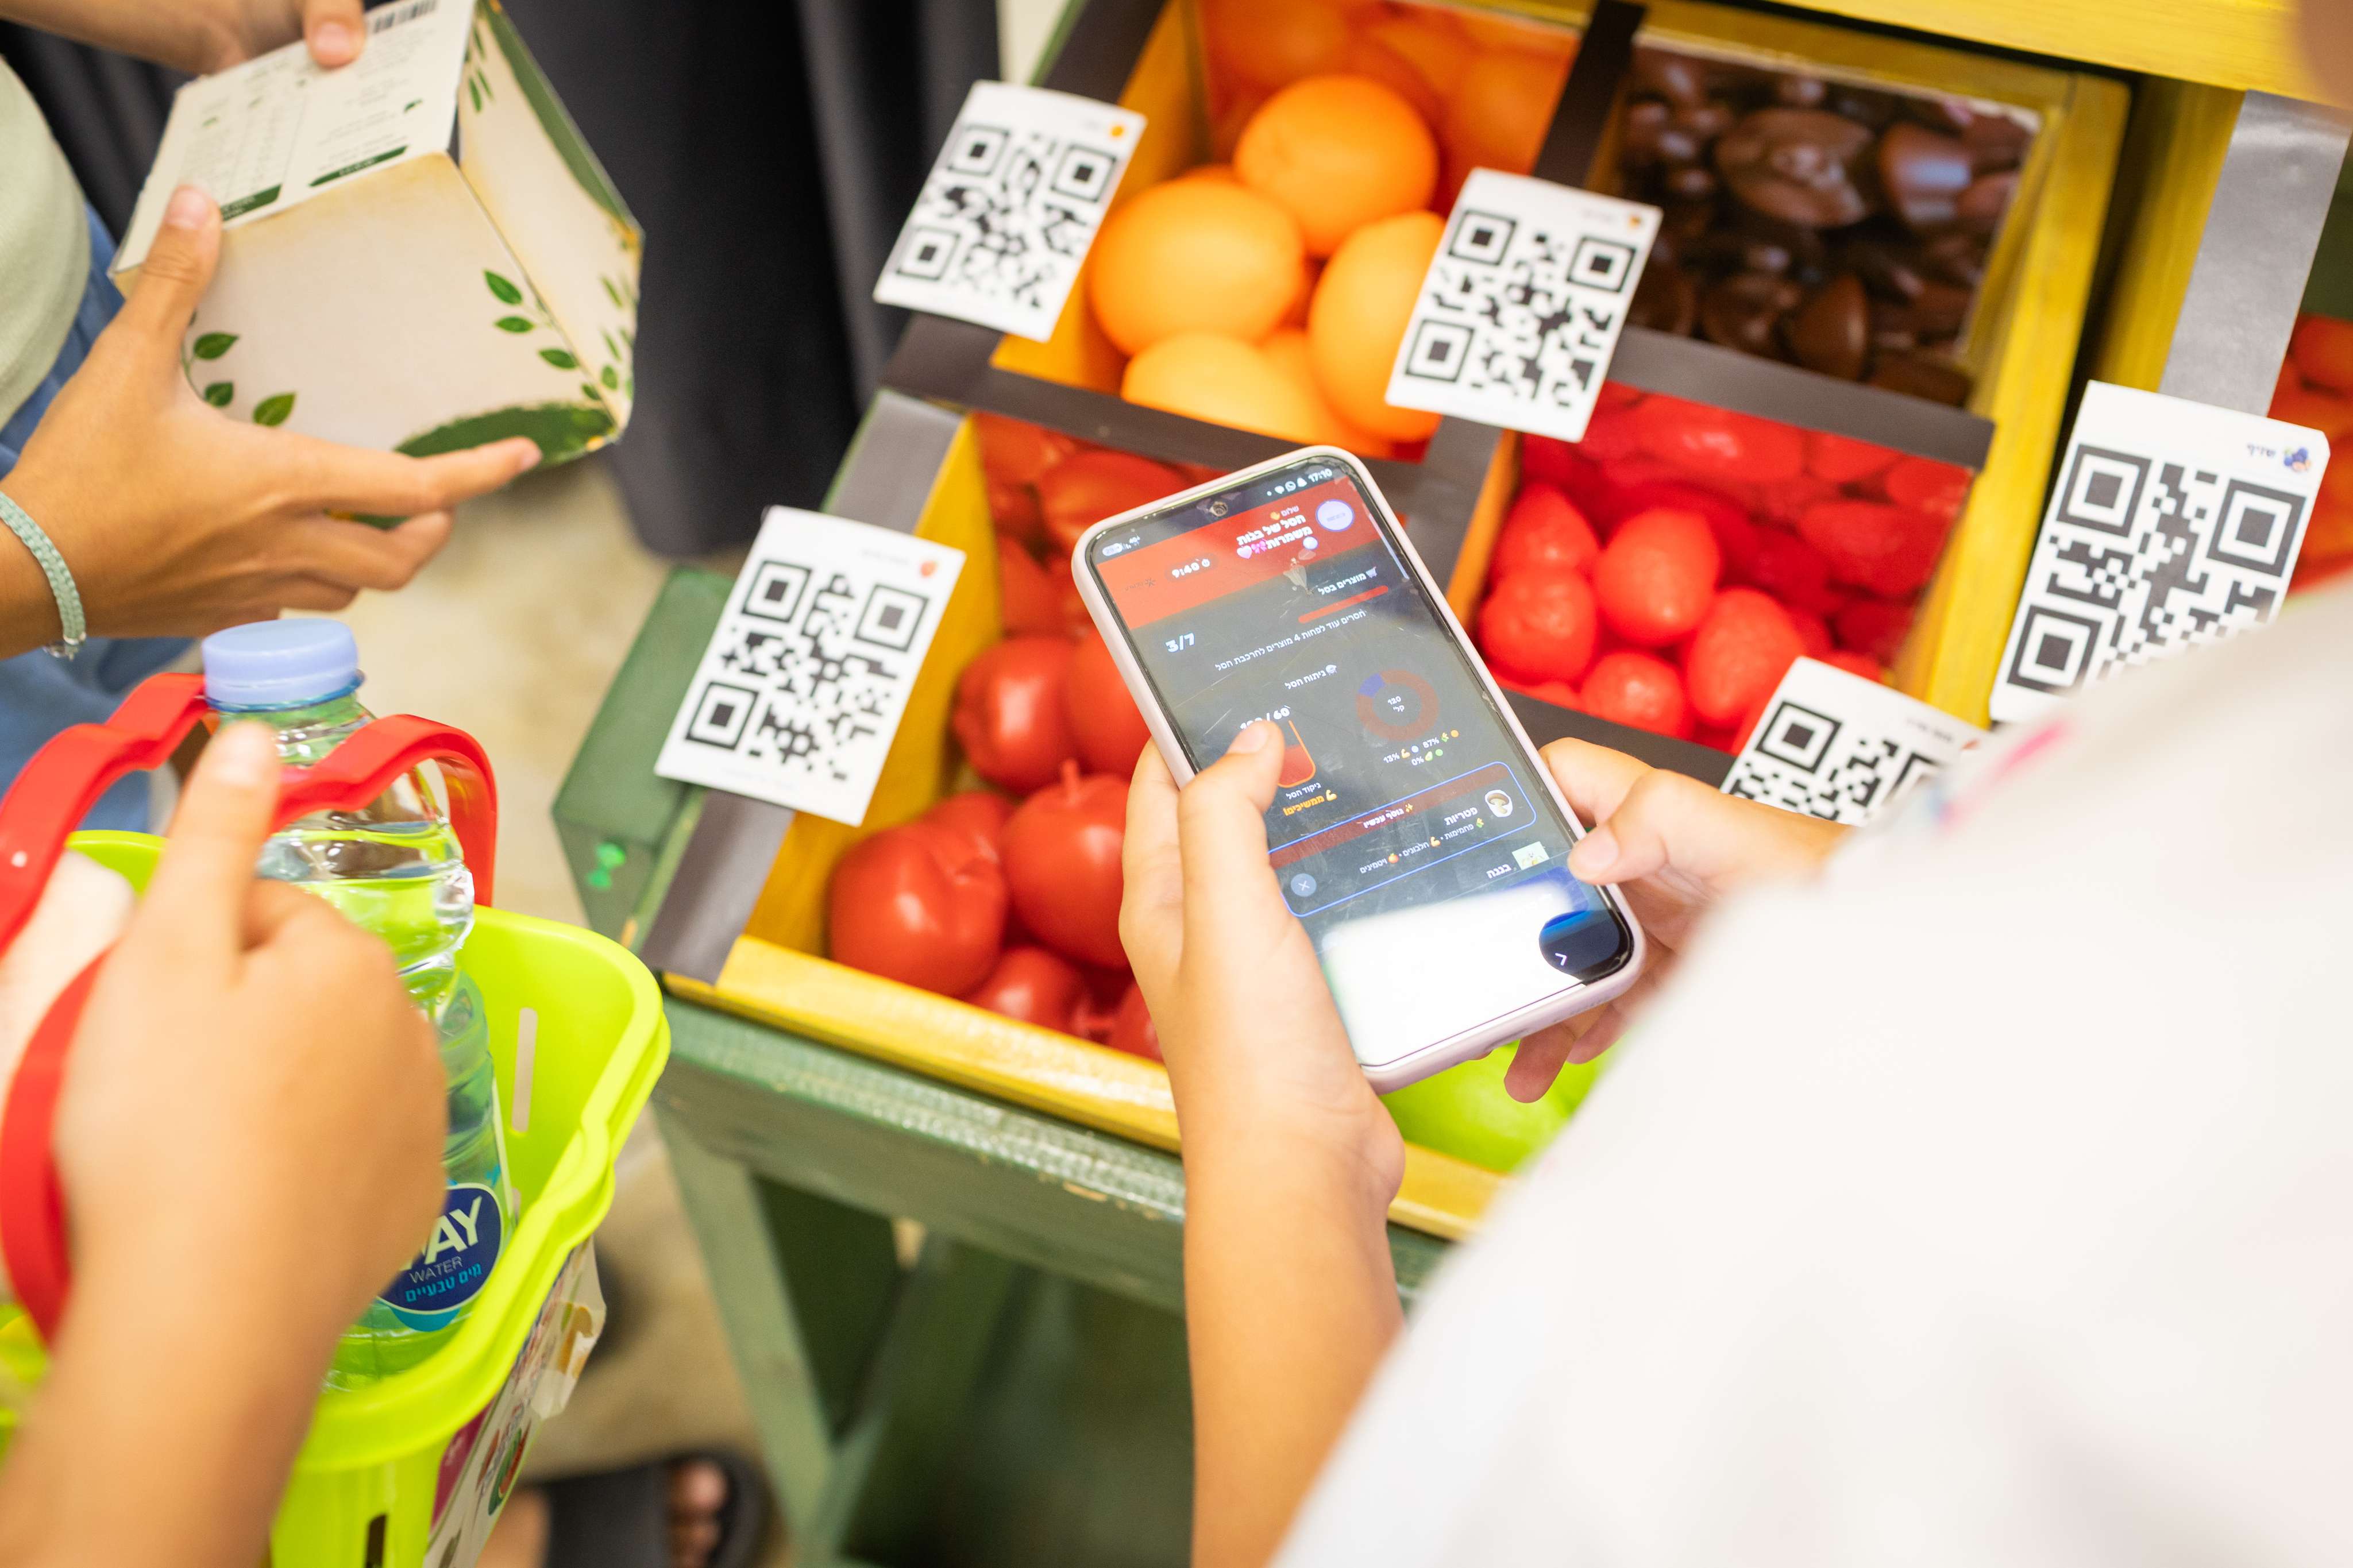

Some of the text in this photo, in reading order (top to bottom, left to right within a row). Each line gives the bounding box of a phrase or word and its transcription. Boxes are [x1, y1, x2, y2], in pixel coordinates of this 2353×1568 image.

[1308, 468, 1333, 482] 17:10
[1280, 505, 1299, 517] שלום
[1236, 514, 1306, 546] הסל של בנות
[1265, 526, 1313, 550] משמרות
[1317, 573, 1367, 595] מוצרים בסל
[1341, 609, 1367, 624] חסרים
[1301, 625, 1326, 639] לפחות
[1326, 620, 1340, 629] עוד
[1165, 632, 1195, 652] 3/7
[1266, 637, 1294, 653] מוצרים
[1294, 634, 1301, 642] 4
[1214, 660, 1233, 671] הסל
[1284, 669, 1327, 690] ניתוח הסל
[1387, 696, 1402, 705] 120
[1273, 707, 1290, 720] 60
[1422, 737, 1440, 748] 87%
[1383, 752, 1400, 763] 13%
[1411, 756, 1425, 766] 0%
[1286, 782, 1321, 800] ניקוד הסל
[1444, 807, 1478, 826] פטריות
[1359, 824, 1474, 874] פחמימות חלבונים ויטמינים
[1486, 864, 1512, 879] בננה
[400, 1195, 483, 1271] AY
[410, 1256, 463, 1284] WATER
[404, 1263, 483, 1303] מים טבעיים
